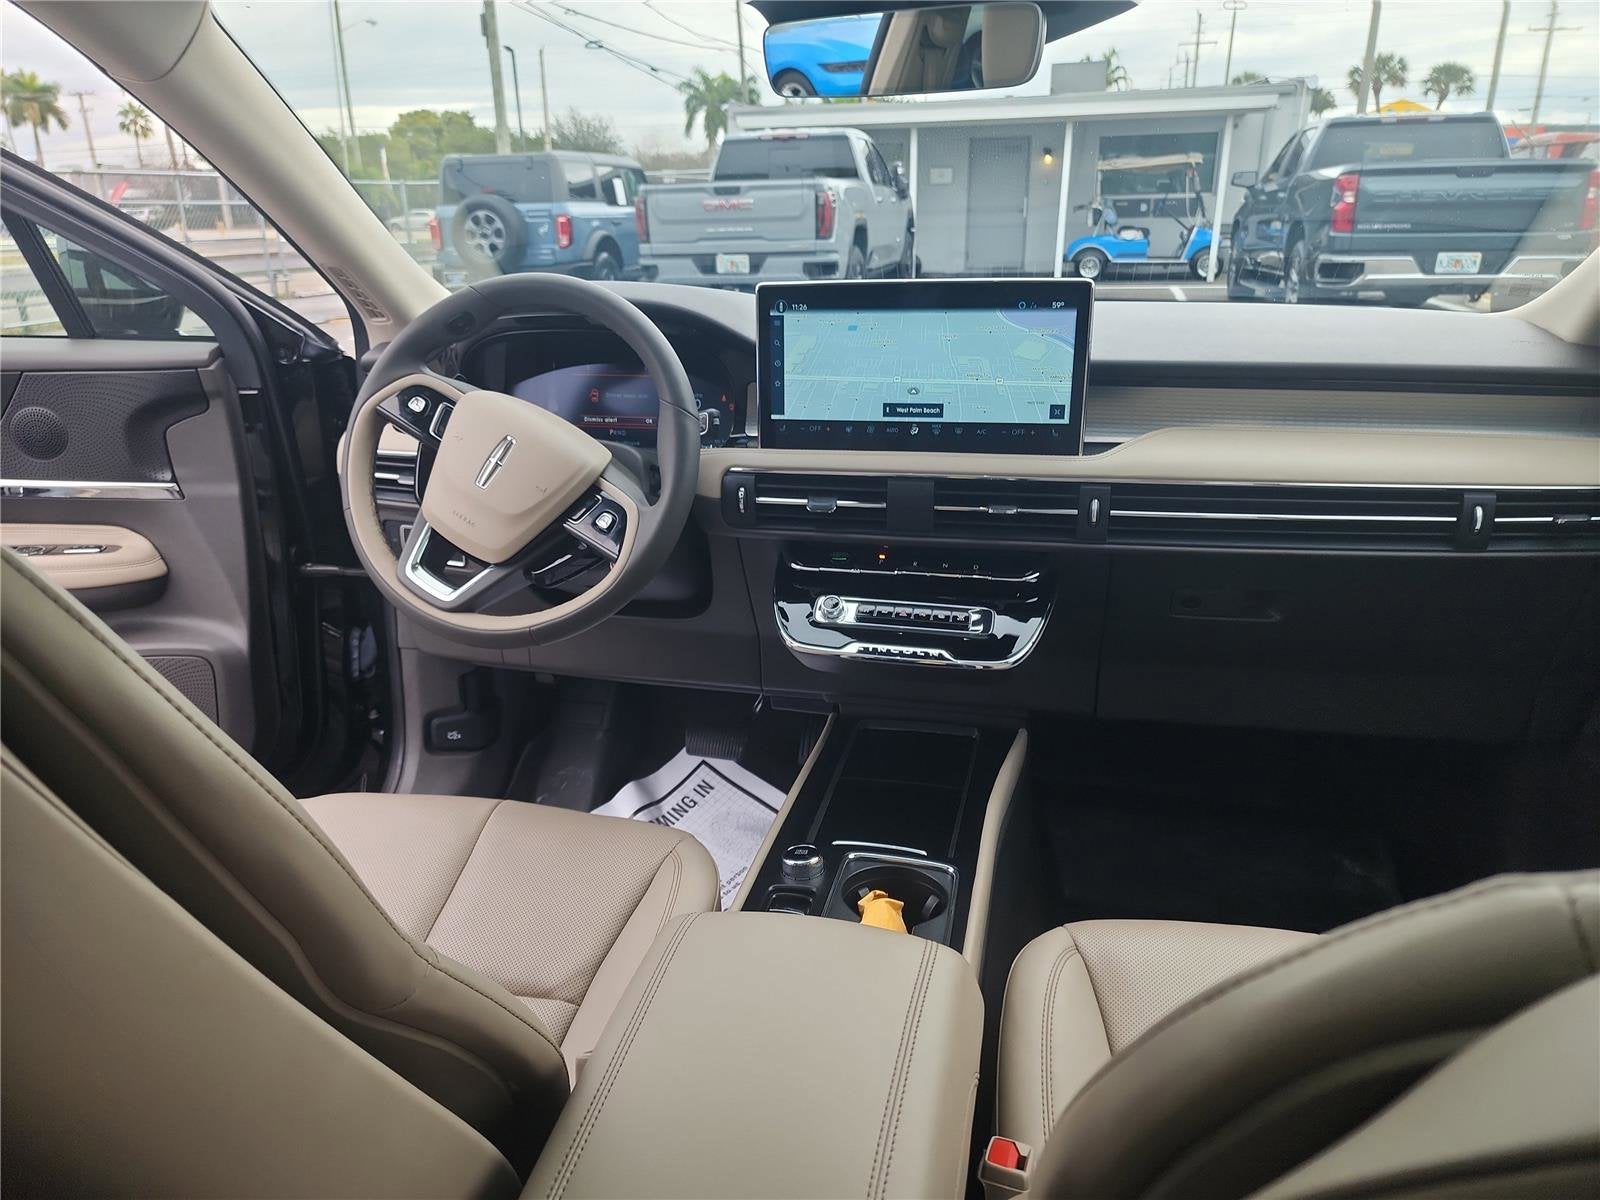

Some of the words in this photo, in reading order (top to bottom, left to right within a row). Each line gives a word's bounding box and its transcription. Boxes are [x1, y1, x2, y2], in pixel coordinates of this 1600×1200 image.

[910, 406, 923, 414] Palm
[809, 425, 821, 433] OFF
[648, 795, 698, 827] MING
[693, 779, 715, 799] IN
